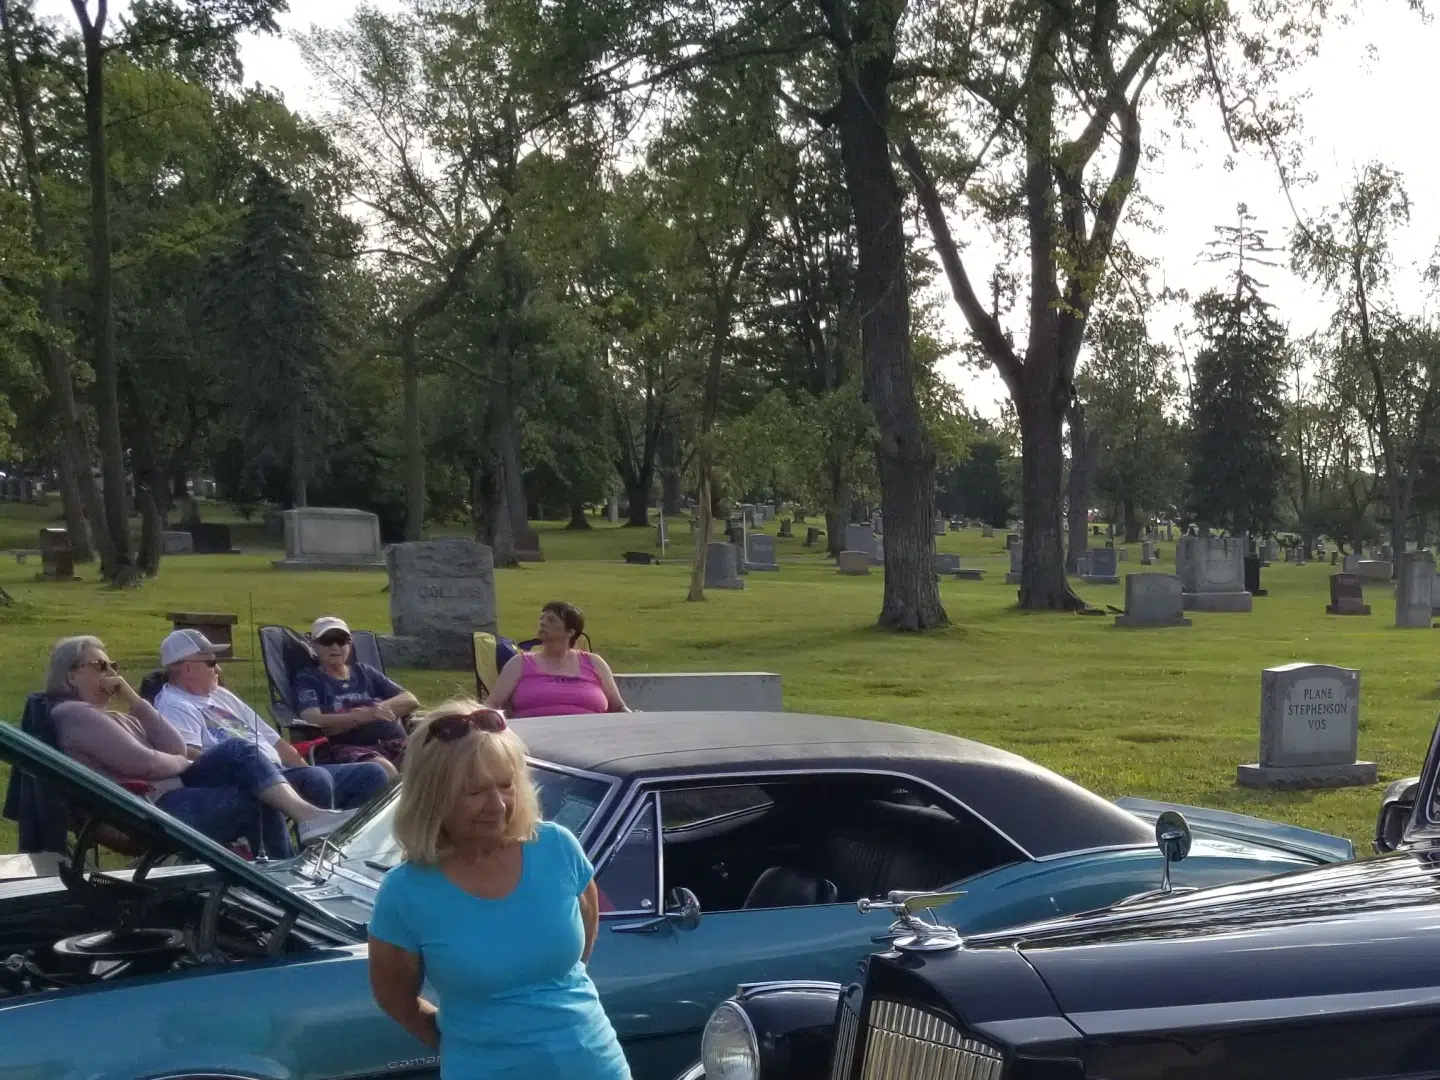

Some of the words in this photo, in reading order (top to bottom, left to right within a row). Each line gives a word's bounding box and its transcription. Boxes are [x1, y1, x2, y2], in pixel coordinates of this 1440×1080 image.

[1303, 688, 1333, 701] PLANE
[1287, 702, 1348, 716] STEPHENSON
[1307, 719, 1327, 731] VOS
